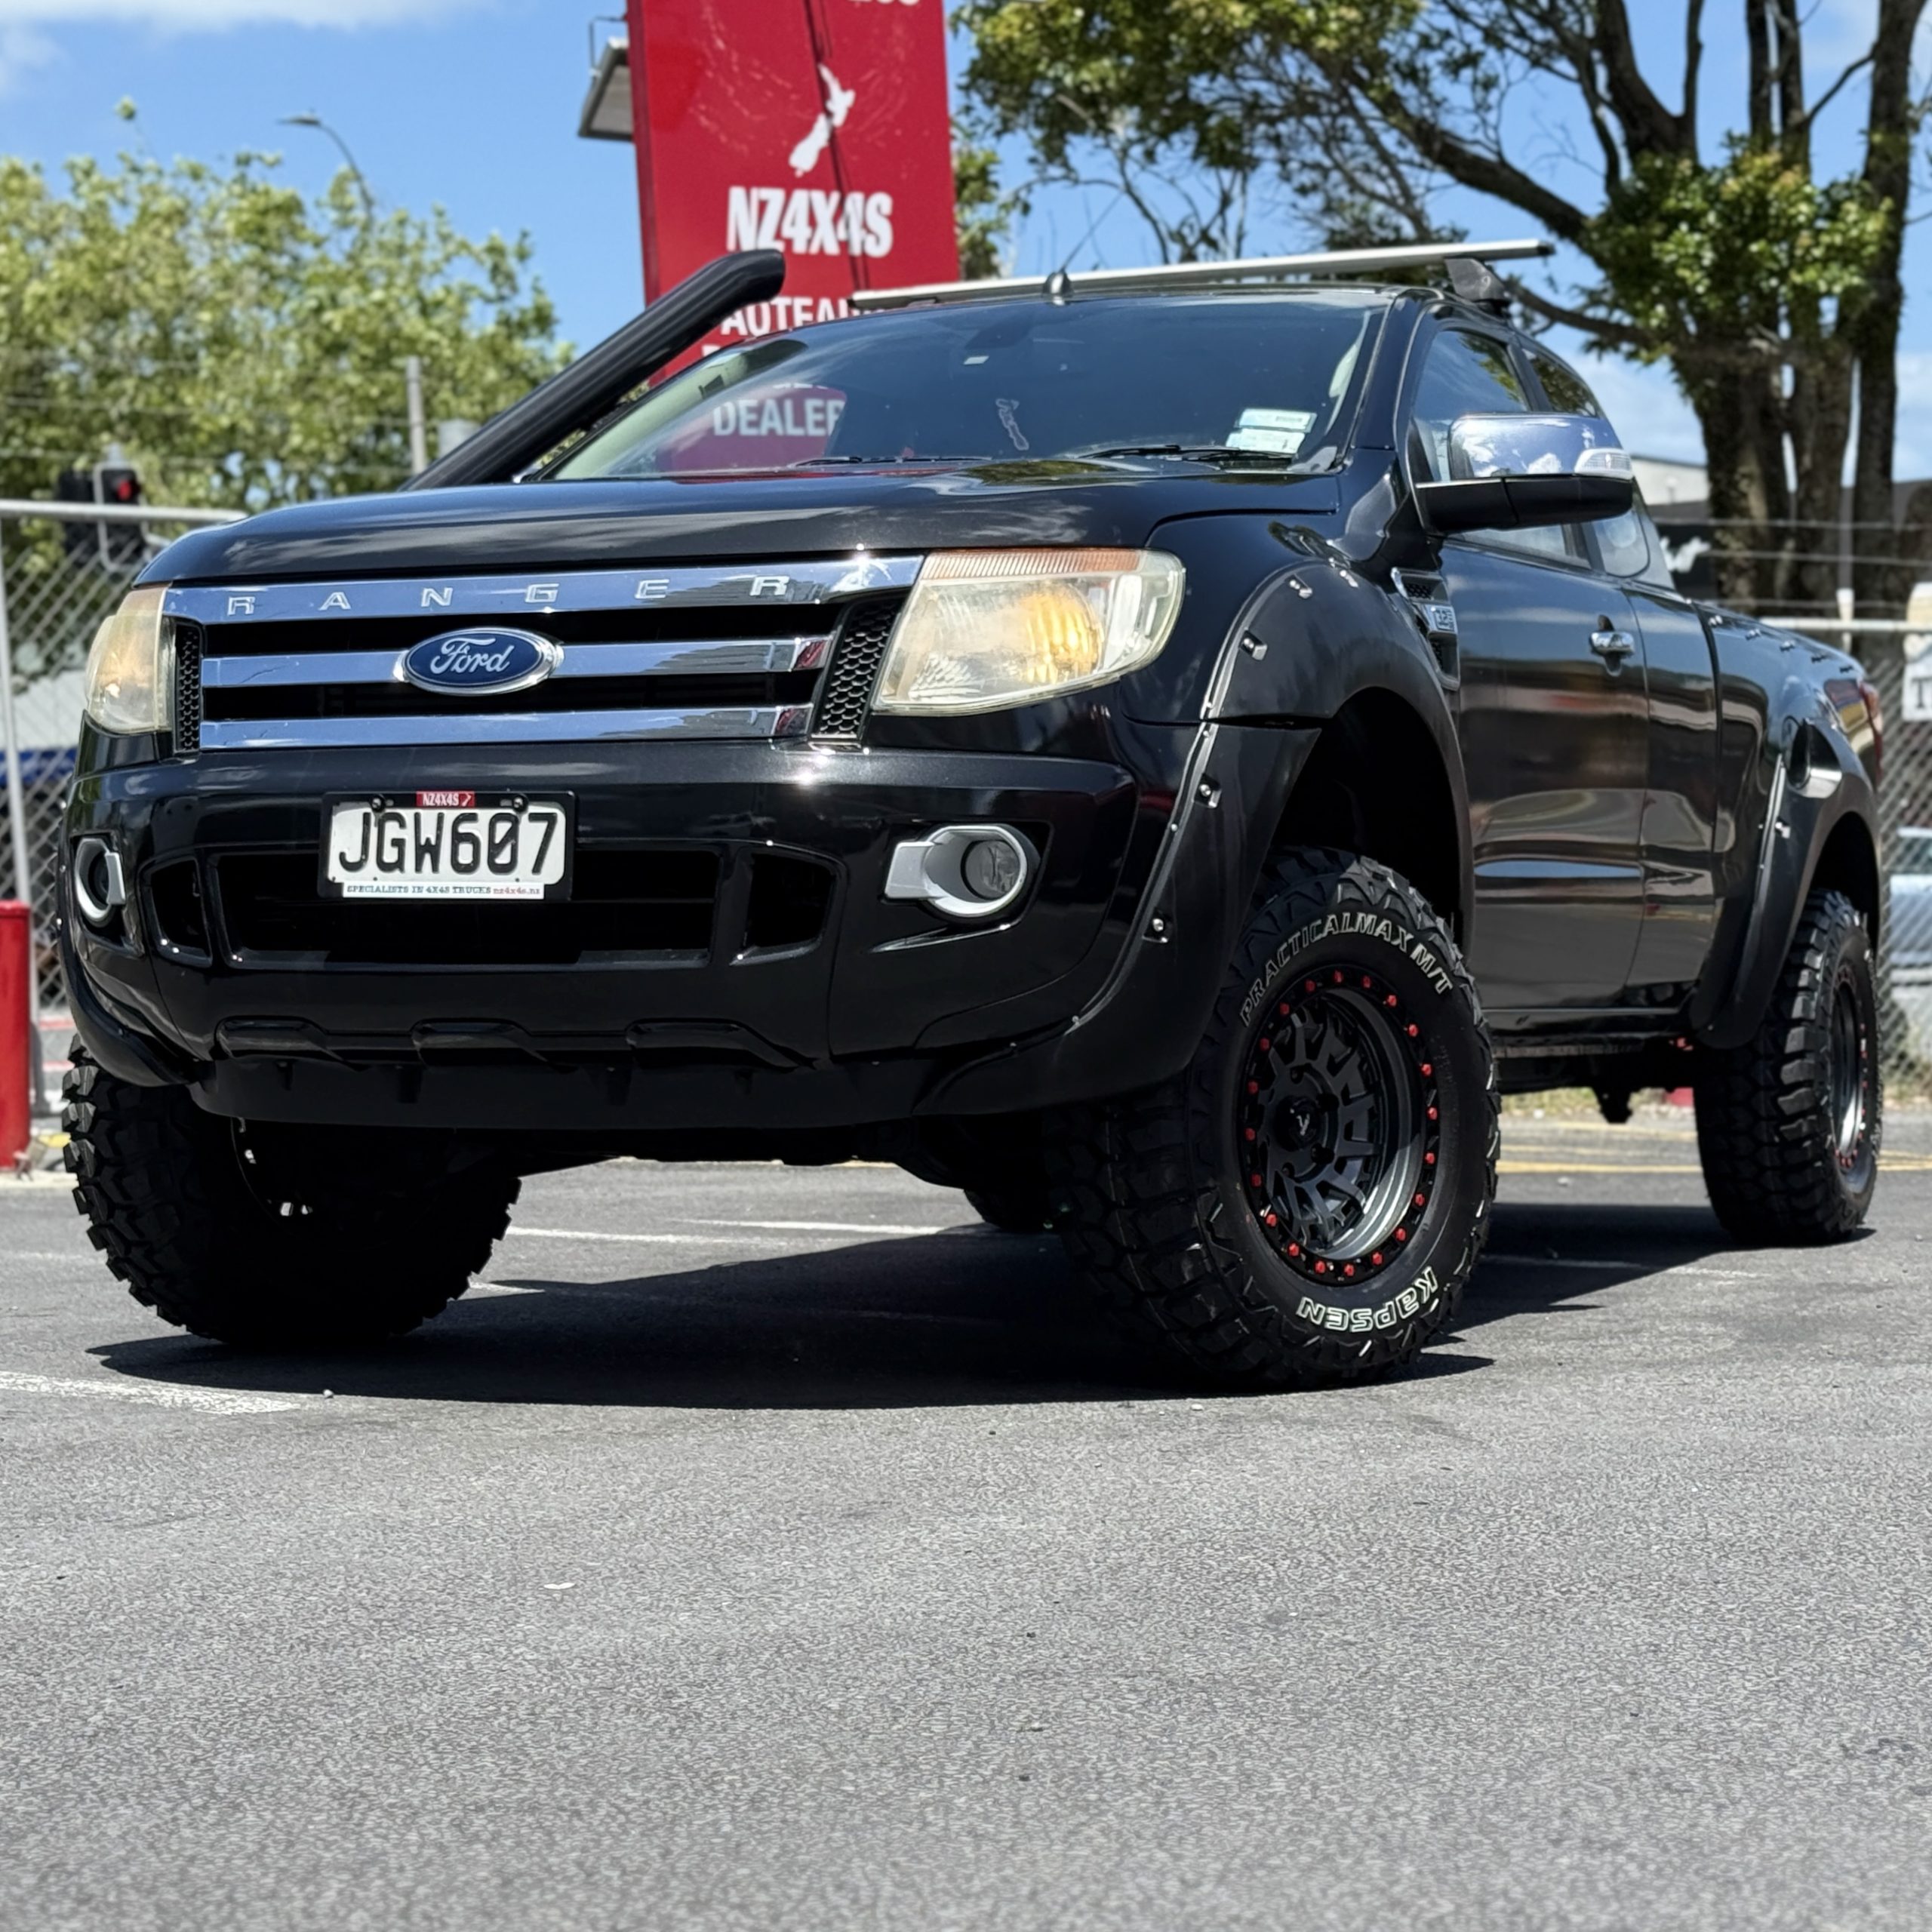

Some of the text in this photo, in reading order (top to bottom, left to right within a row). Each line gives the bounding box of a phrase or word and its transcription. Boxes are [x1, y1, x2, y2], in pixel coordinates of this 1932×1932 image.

[726, 185, 894, 258] NZ4X4S
[226, 575, 790, 616] RANGER
[430, 636, 511, 674] Ford
[423, 792, 459, 807] NZ4X4S
[339, 812, 559, 875] JGW607
[346, 885, 409, 894] SPECIALISTS
[411, 886, 423, 894] IN
[452, 887, 491, 895] TRUCKS
[1239, 912, 1453, 1027] PRACTICALMAX M/T
